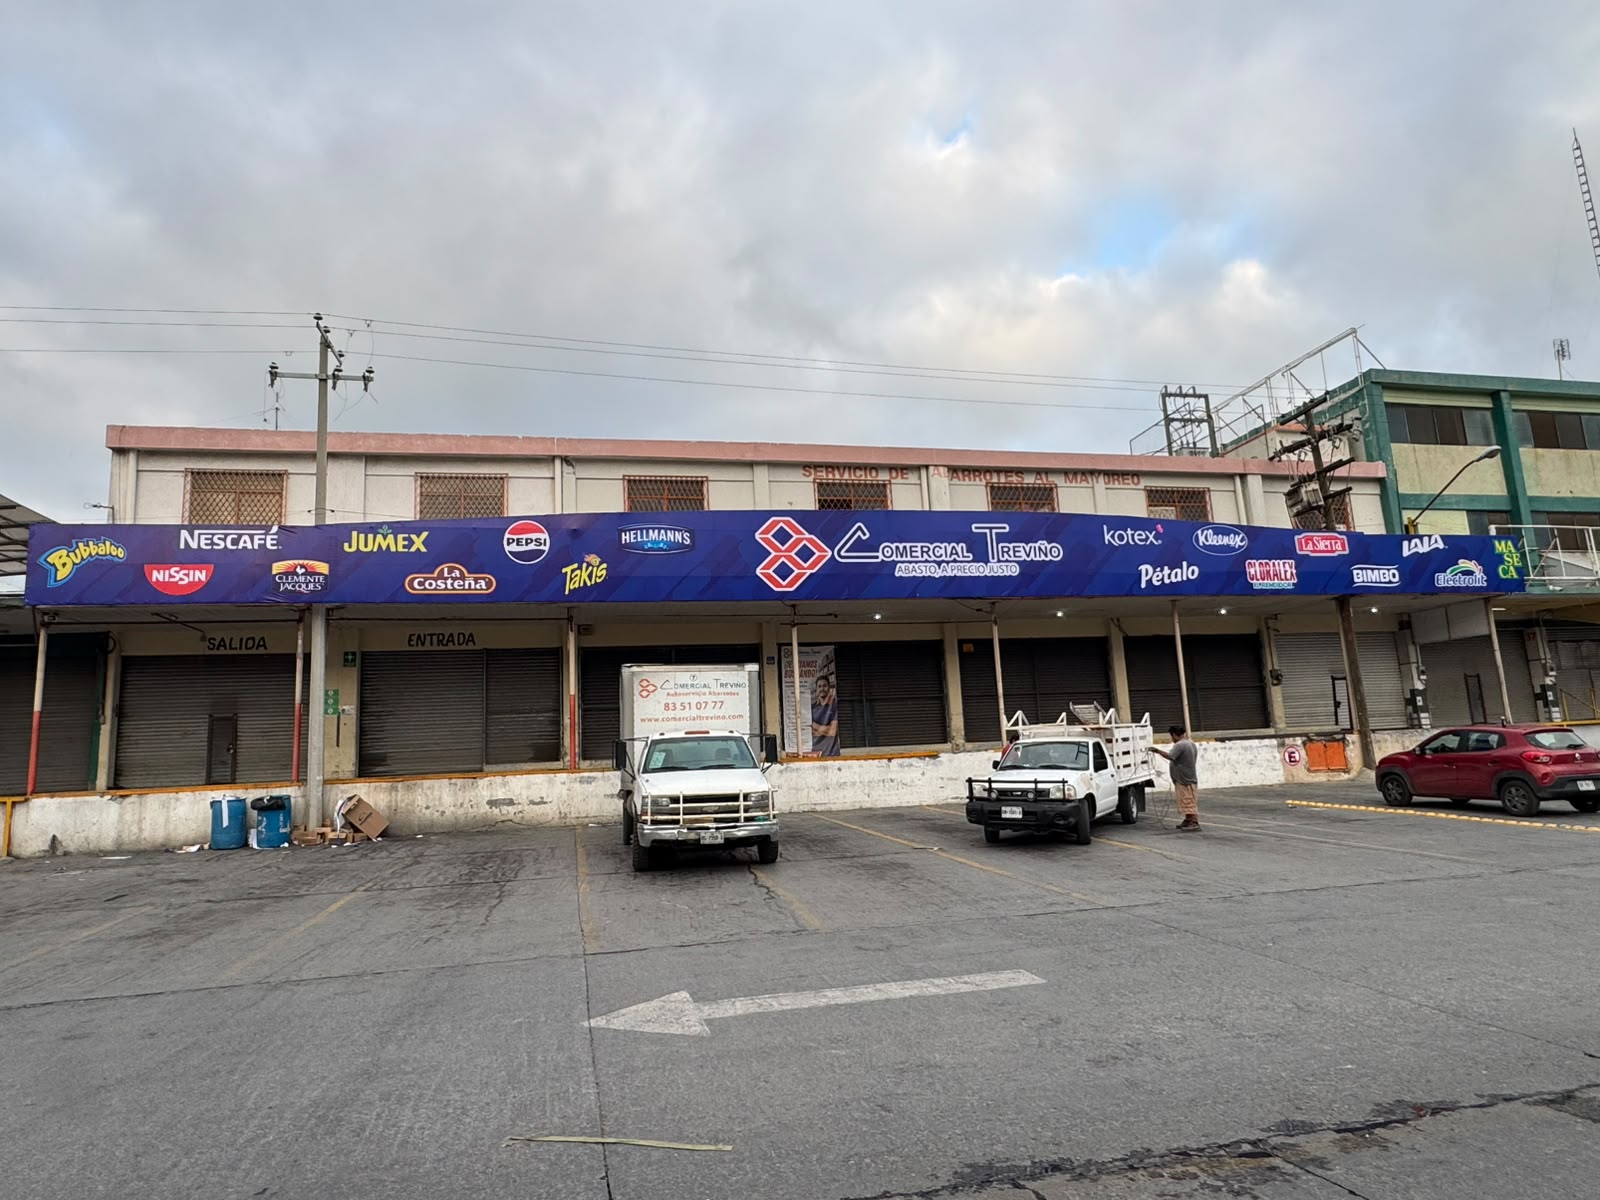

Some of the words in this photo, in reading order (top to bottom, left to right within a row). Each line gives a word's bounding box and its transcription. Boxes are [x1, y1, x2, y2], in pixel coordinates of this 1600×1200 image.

[801, 465, 879, 479] SERVICIO
[888, 467, 909, 480] DE
[1033, 473, 1055, 484] AL
[1063, 471, 1141, 486] MAYOREO
[179, 525, 279, 549] NESCAFÉ
[343, 530, 430, 553] JUMEX
[506, 537, 547, 548] PEPSI
[621, 528, 691, 545] HELLMANN'S
[835, 523, 973, 562] COMERCIAL
[972, 524, 1063, 562] TREVIÑO
[1103, 524, 1158, 546] kotex
[1197, 529, 1246, 549] Kleenex
[1301, 538, 1313, 550] La
[1313, 536, 1343, 551] Sierra
[1402, 535, 1445, 557] LALA
[1493, 540, 1516, 553] MA
[47, 540, 125, 579] Bubbaloo
[1503, 552, 1522, 566] SE
[151, 567, 207, 585] NISSIN
[443, 567, 460, 578] La
[562, 559, 607, 594] Takis
[895, 562, 940, 577] ABASTO,
[940, 563, 949, 576] A
[950, 563, 986, 576] PRECIO
[986, 563, 1020, 576] JUSTO
[1138, 561, 1199, 588] Pétalo
[1247, 560, 1297, 582] CLORALEX
[1352, 567, 1399, 584] BIMBO
[1498, 565, 1519, 579] CA
[275, 574, 326, 583] CLEMENTE
[413, 577, 487, 590] Costeña
[1435, 572, 1487, 587] Electrolit
[280, 583, 322, 593] JACQUES
[207, 636, 268, 650] SALIDA
[407, 631, 476, 647] ENTRADA
[660, 679, 711, 690] COMERCIAL
[663, 702, 677, 712] 83
[680, 702, 692, 711] 51
[695, 701, 709, 711] 07
[711, 700, 725, 710] 77
[1288, 751, 1298, 763] E
